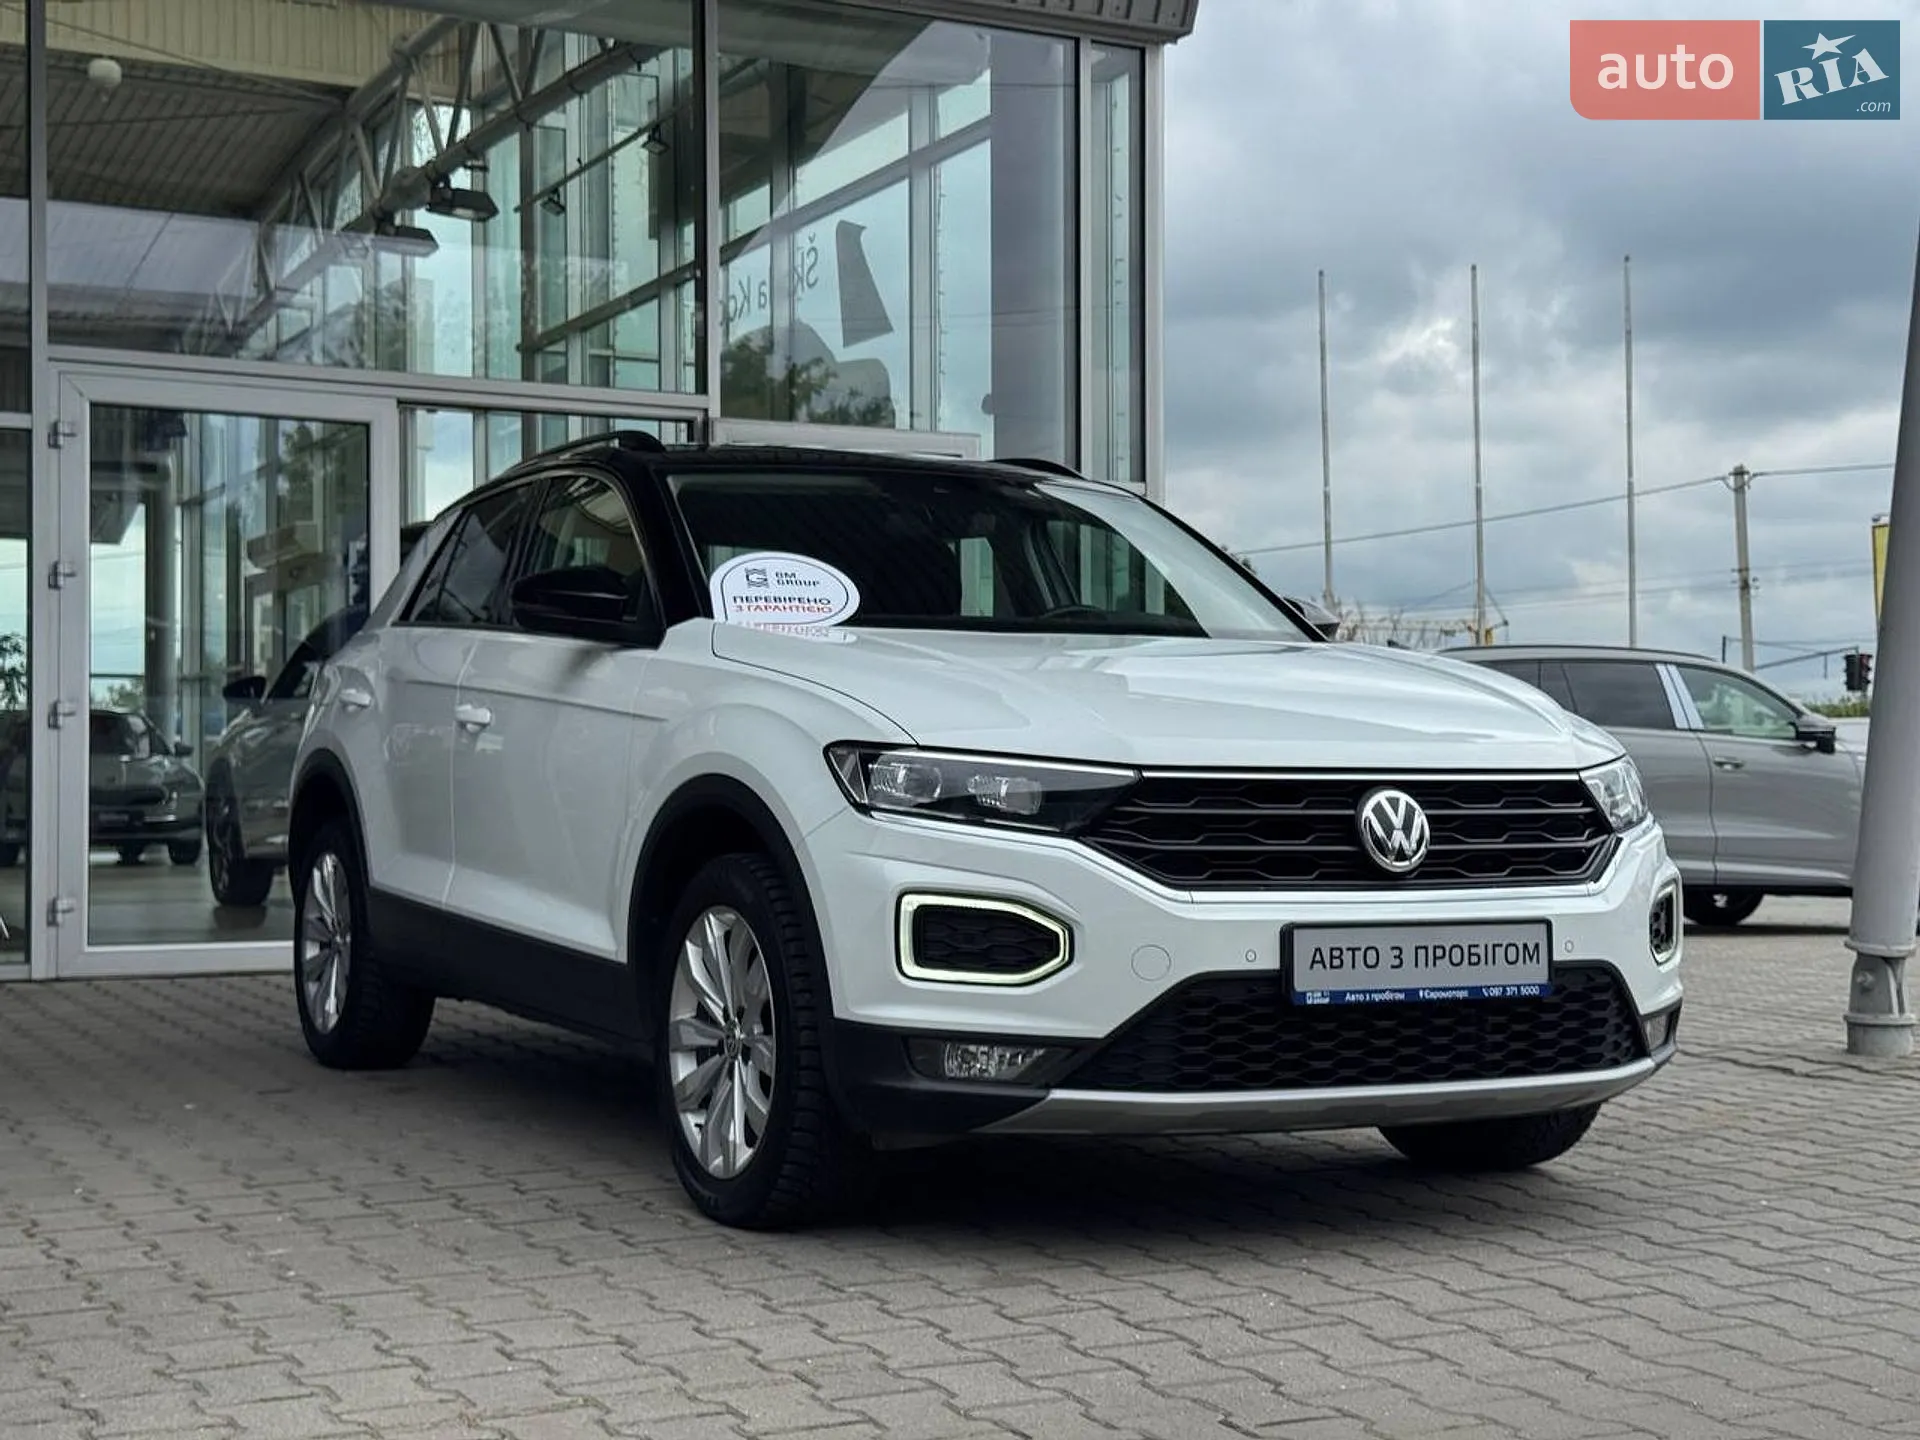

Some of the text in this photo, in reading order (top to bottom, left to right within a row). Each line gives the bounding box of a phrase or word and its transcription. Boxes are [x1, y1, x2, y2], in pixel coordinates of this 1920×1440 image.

[776, 578, 820, 588] GROUP
[732, 595, 831, 606] ПЕРЕВІРЕНО
[1309, 942, 1541, 971] АВТО З ПРОБІГОМ
